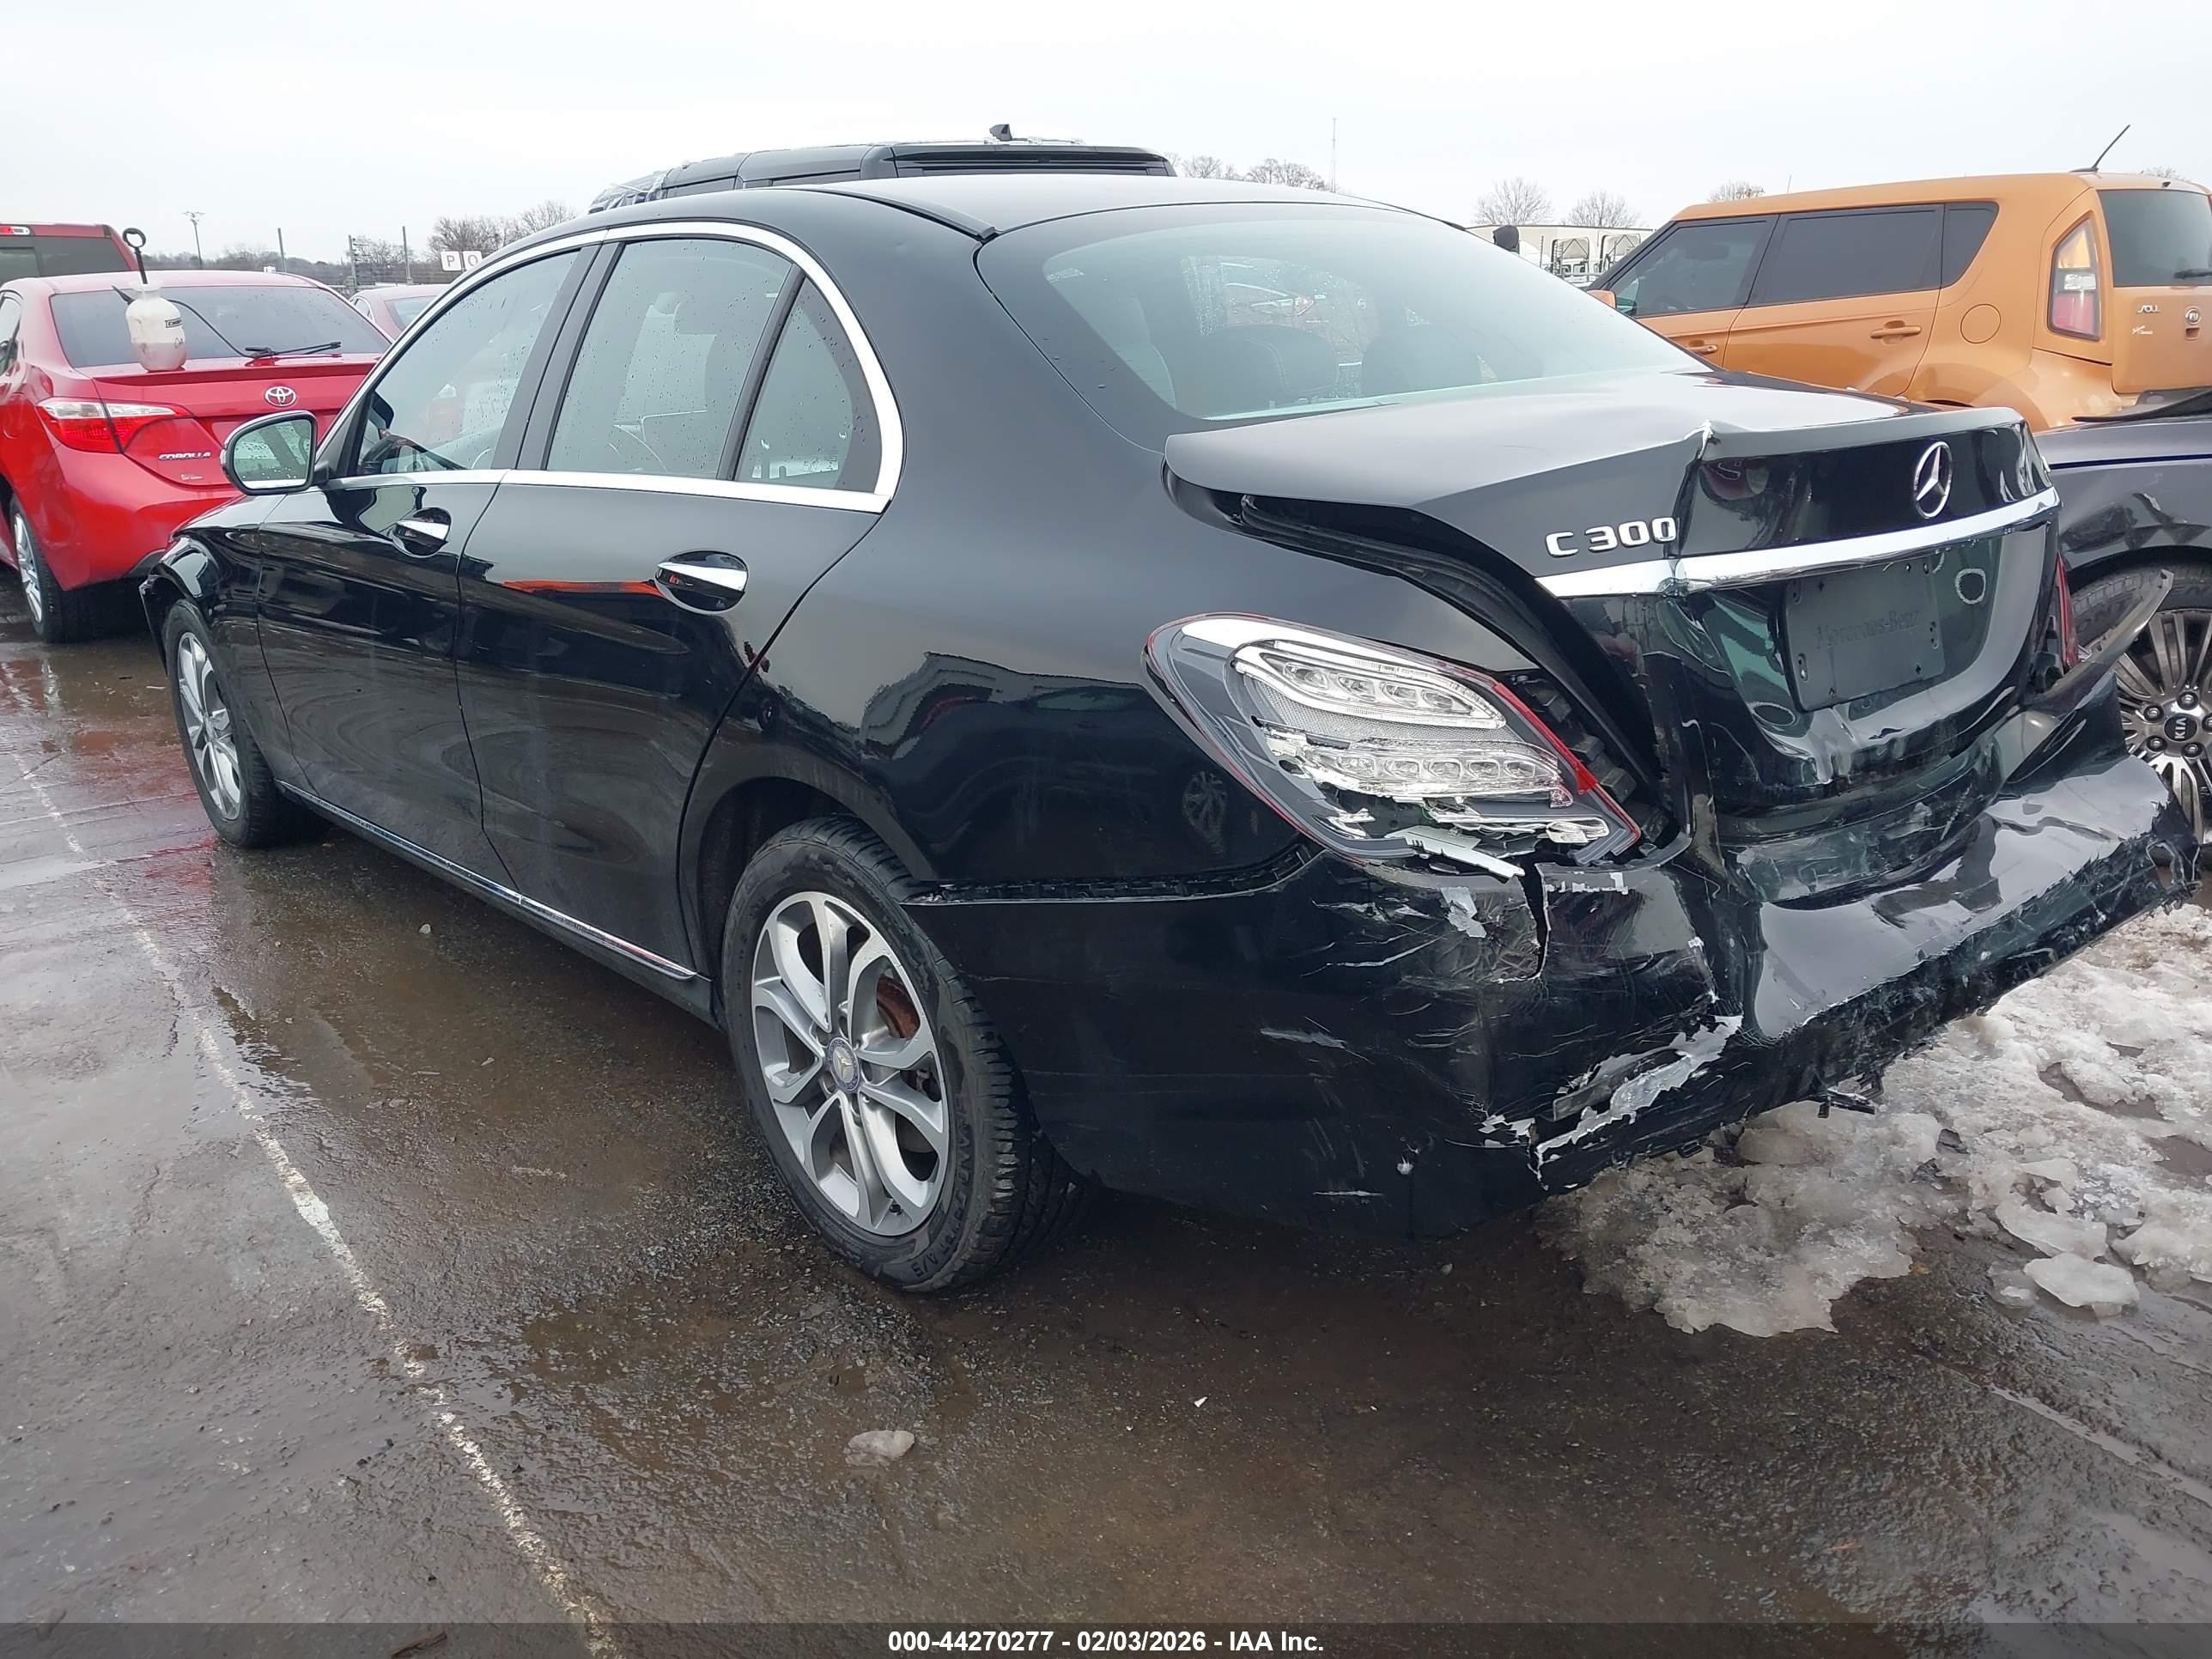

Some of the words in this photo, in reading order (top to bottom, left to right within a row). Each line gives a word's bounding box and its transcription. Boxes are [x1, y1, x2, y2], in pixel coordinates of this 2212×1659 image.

[447, 255, 455, 267] P
[159, 452, 211, 460] COROLLA
[1546, 532, 1580, 557] C
[1585, 517, 1677, 553] 300
[1816, 609, 1921, 649] Mercedes-Benz
[2175, 718, 2186, 738] KIA
